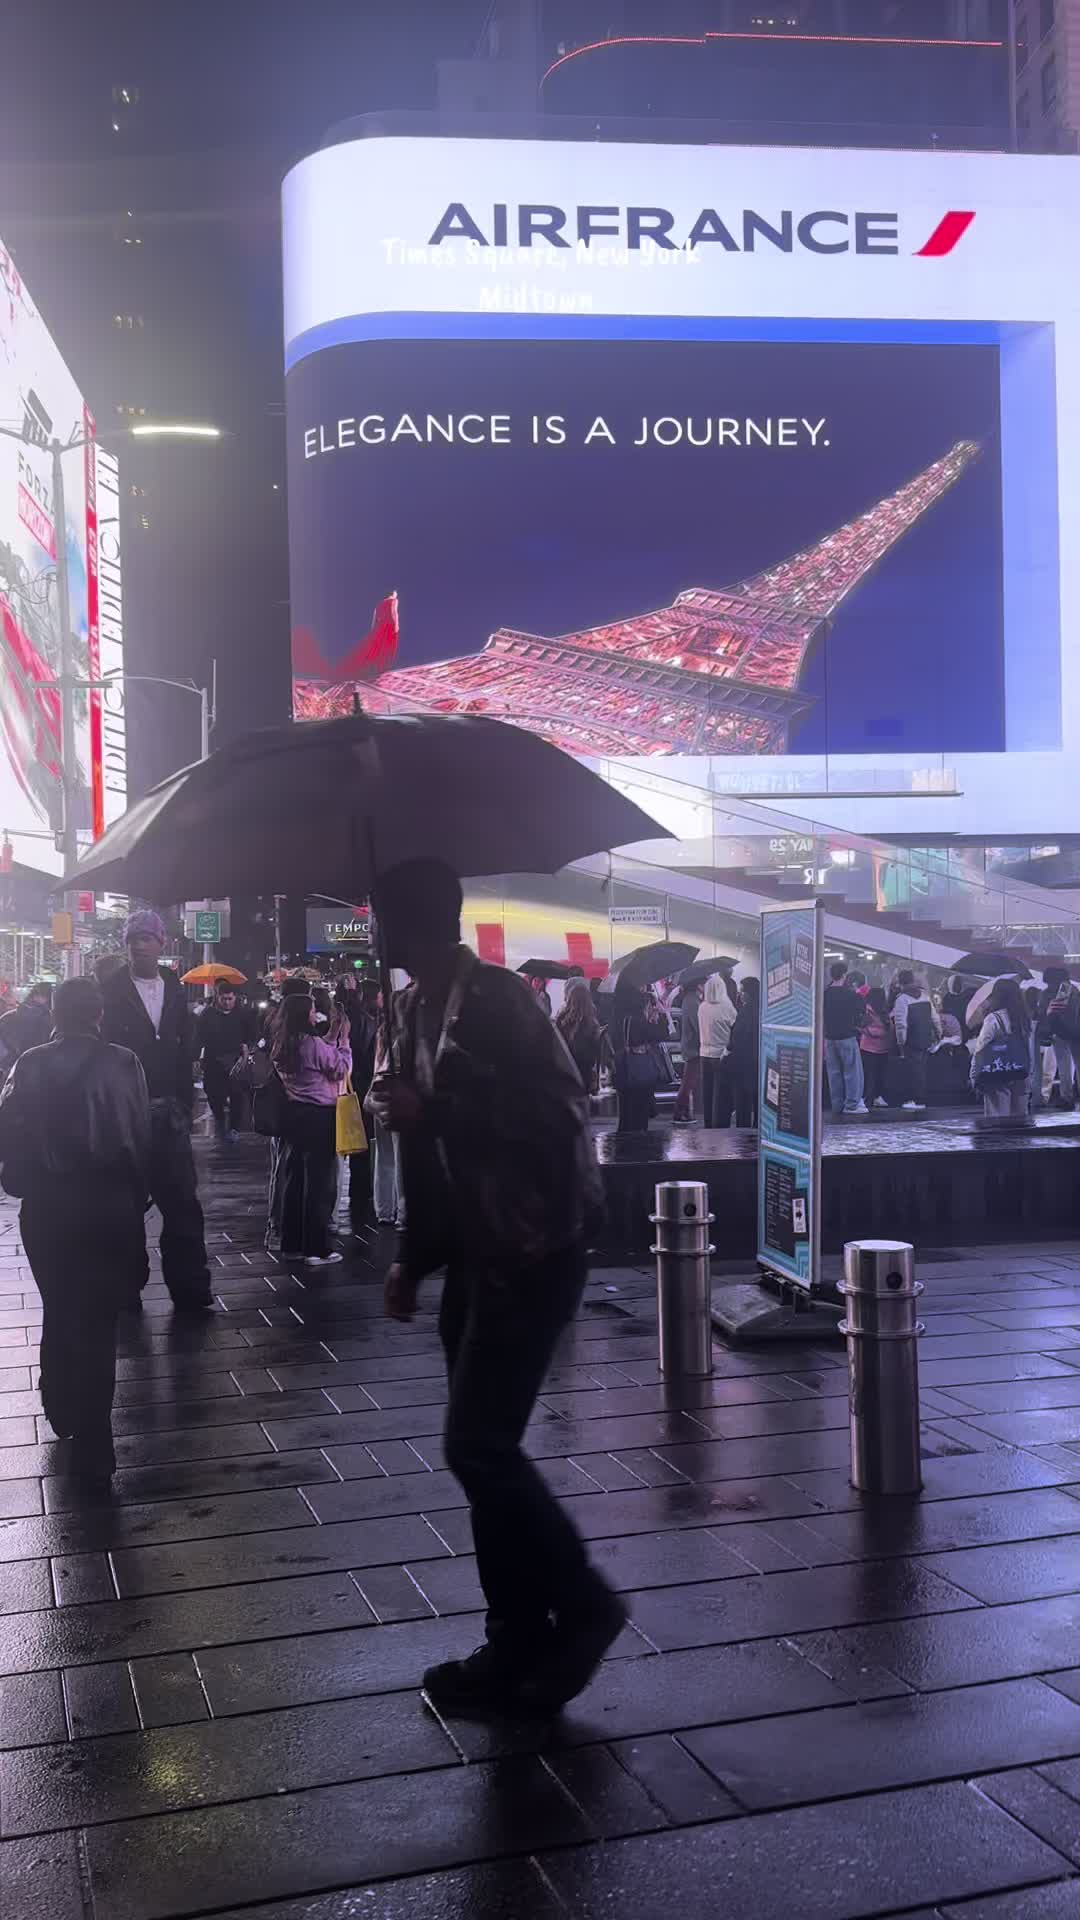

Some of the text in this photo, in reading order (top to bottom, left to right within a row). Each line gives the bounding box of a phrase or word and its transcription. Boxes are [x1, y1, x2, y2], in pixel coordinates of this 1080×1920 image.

[428, 202, 899, 254] AIRFRANCE
[304, 413, 830, 458] ELEGANCE IS A JOURNEY.
[99, 516, 123, 645] EDITION
[102, 667, 128, 794] EDITION
